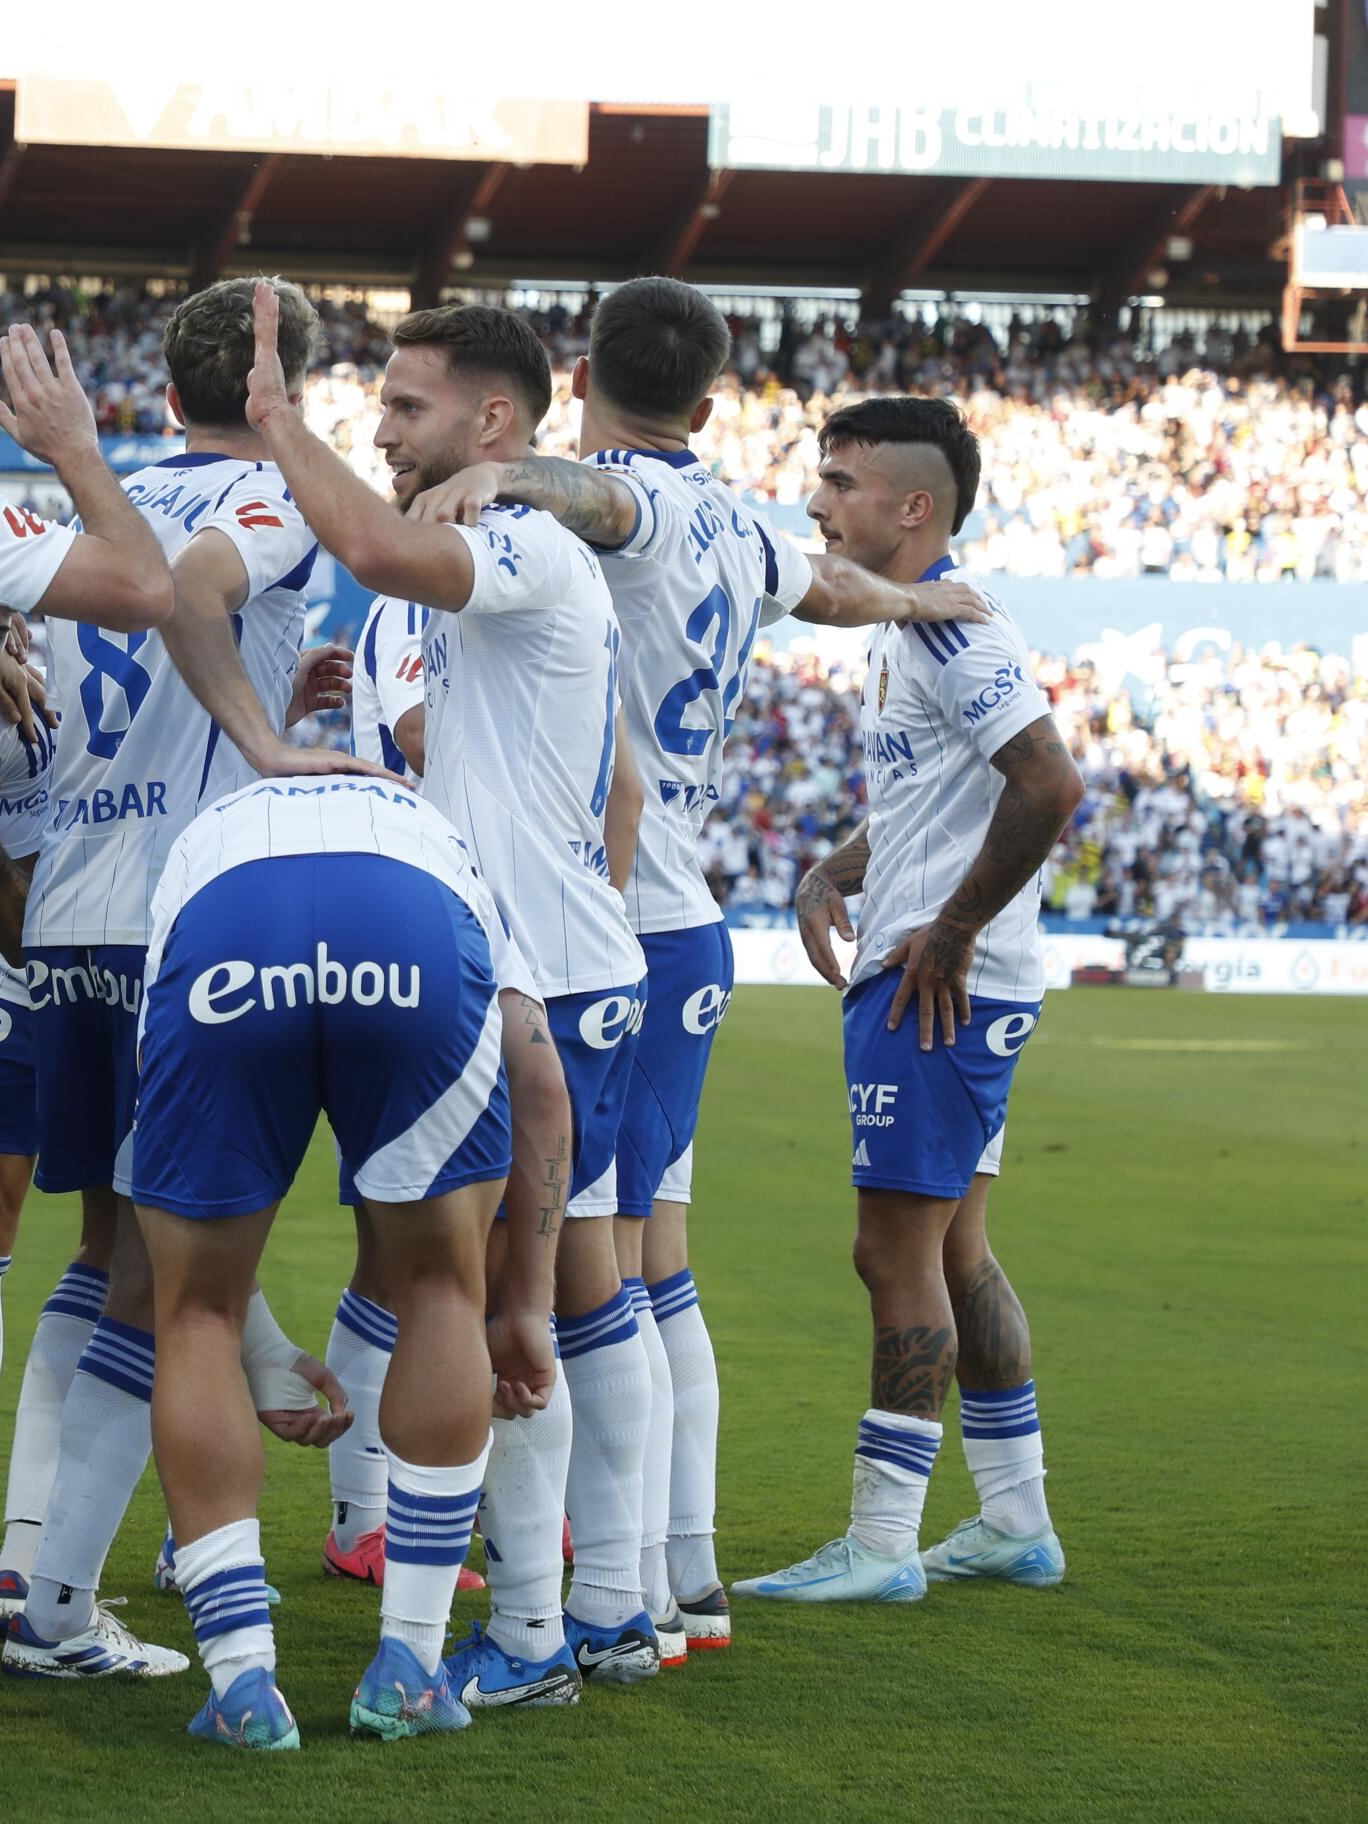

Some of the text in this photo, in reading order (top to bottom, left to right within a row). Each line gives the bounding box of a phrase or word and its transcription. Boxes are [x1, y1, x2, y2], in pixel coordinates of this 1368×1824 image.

[75, 620, 152, 761] 8
[962, 675, 1015, 726] MGS
[188, 942, 420, 1025] embou
[848, 1083, 899, 1114] CYF
[855, 1114, 895, 1128] GROUP
